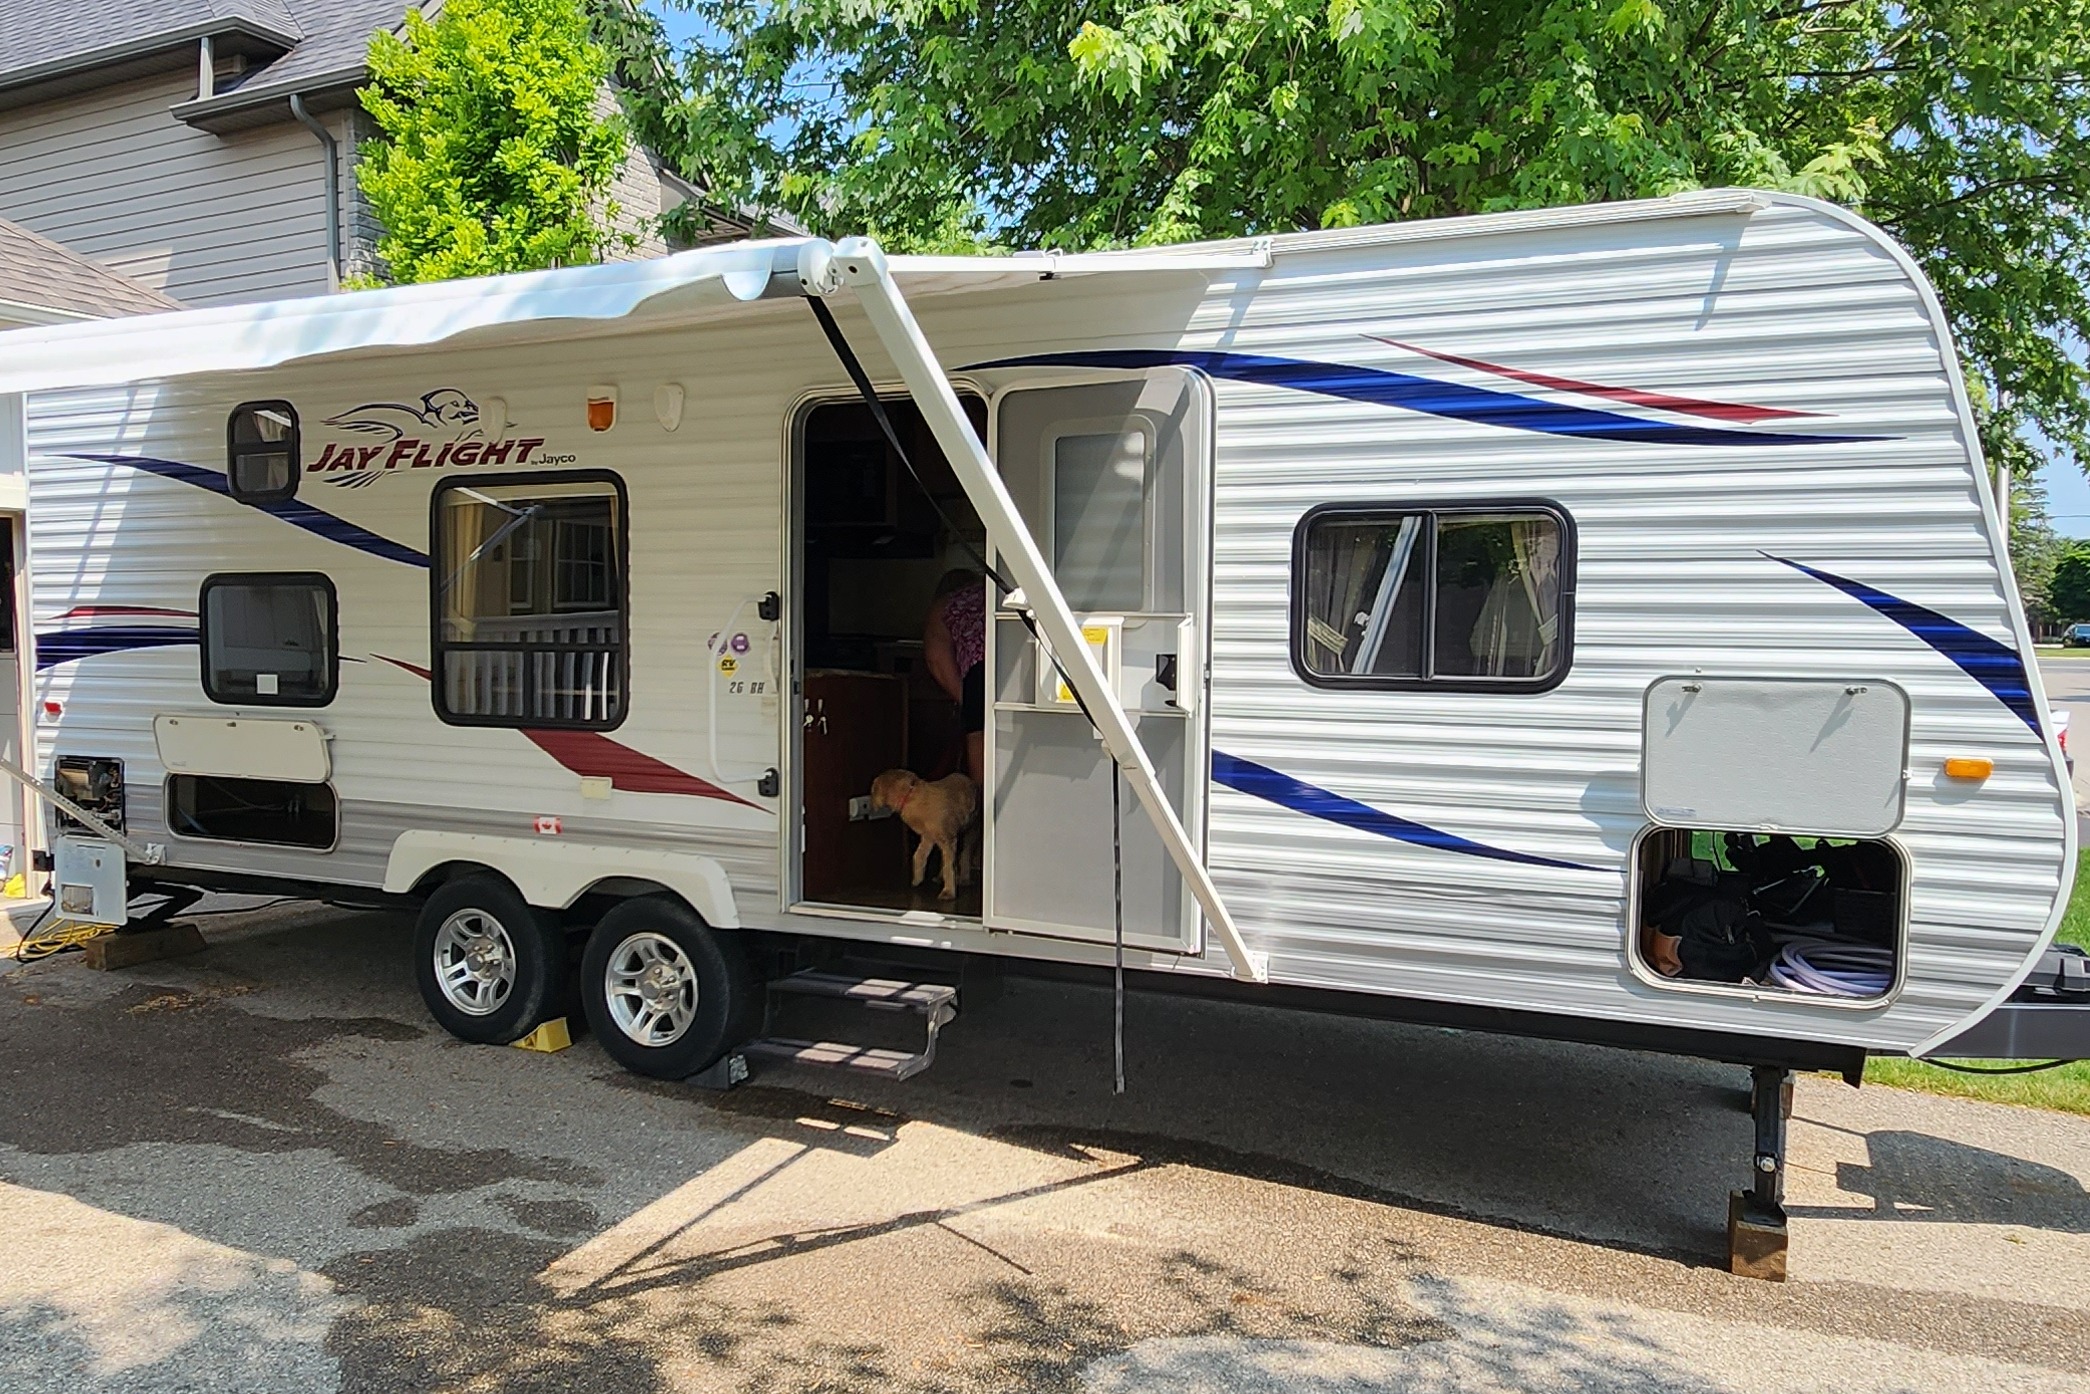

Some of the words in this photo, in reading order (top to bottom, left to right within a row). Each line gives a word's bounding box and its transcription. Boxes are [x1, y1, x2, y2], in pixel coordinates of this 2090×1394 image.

[307, 443, 386, 472] JAY
[385, 438, 545, 469] FLIGHT
[539, 453, 577, 466] Jayco
